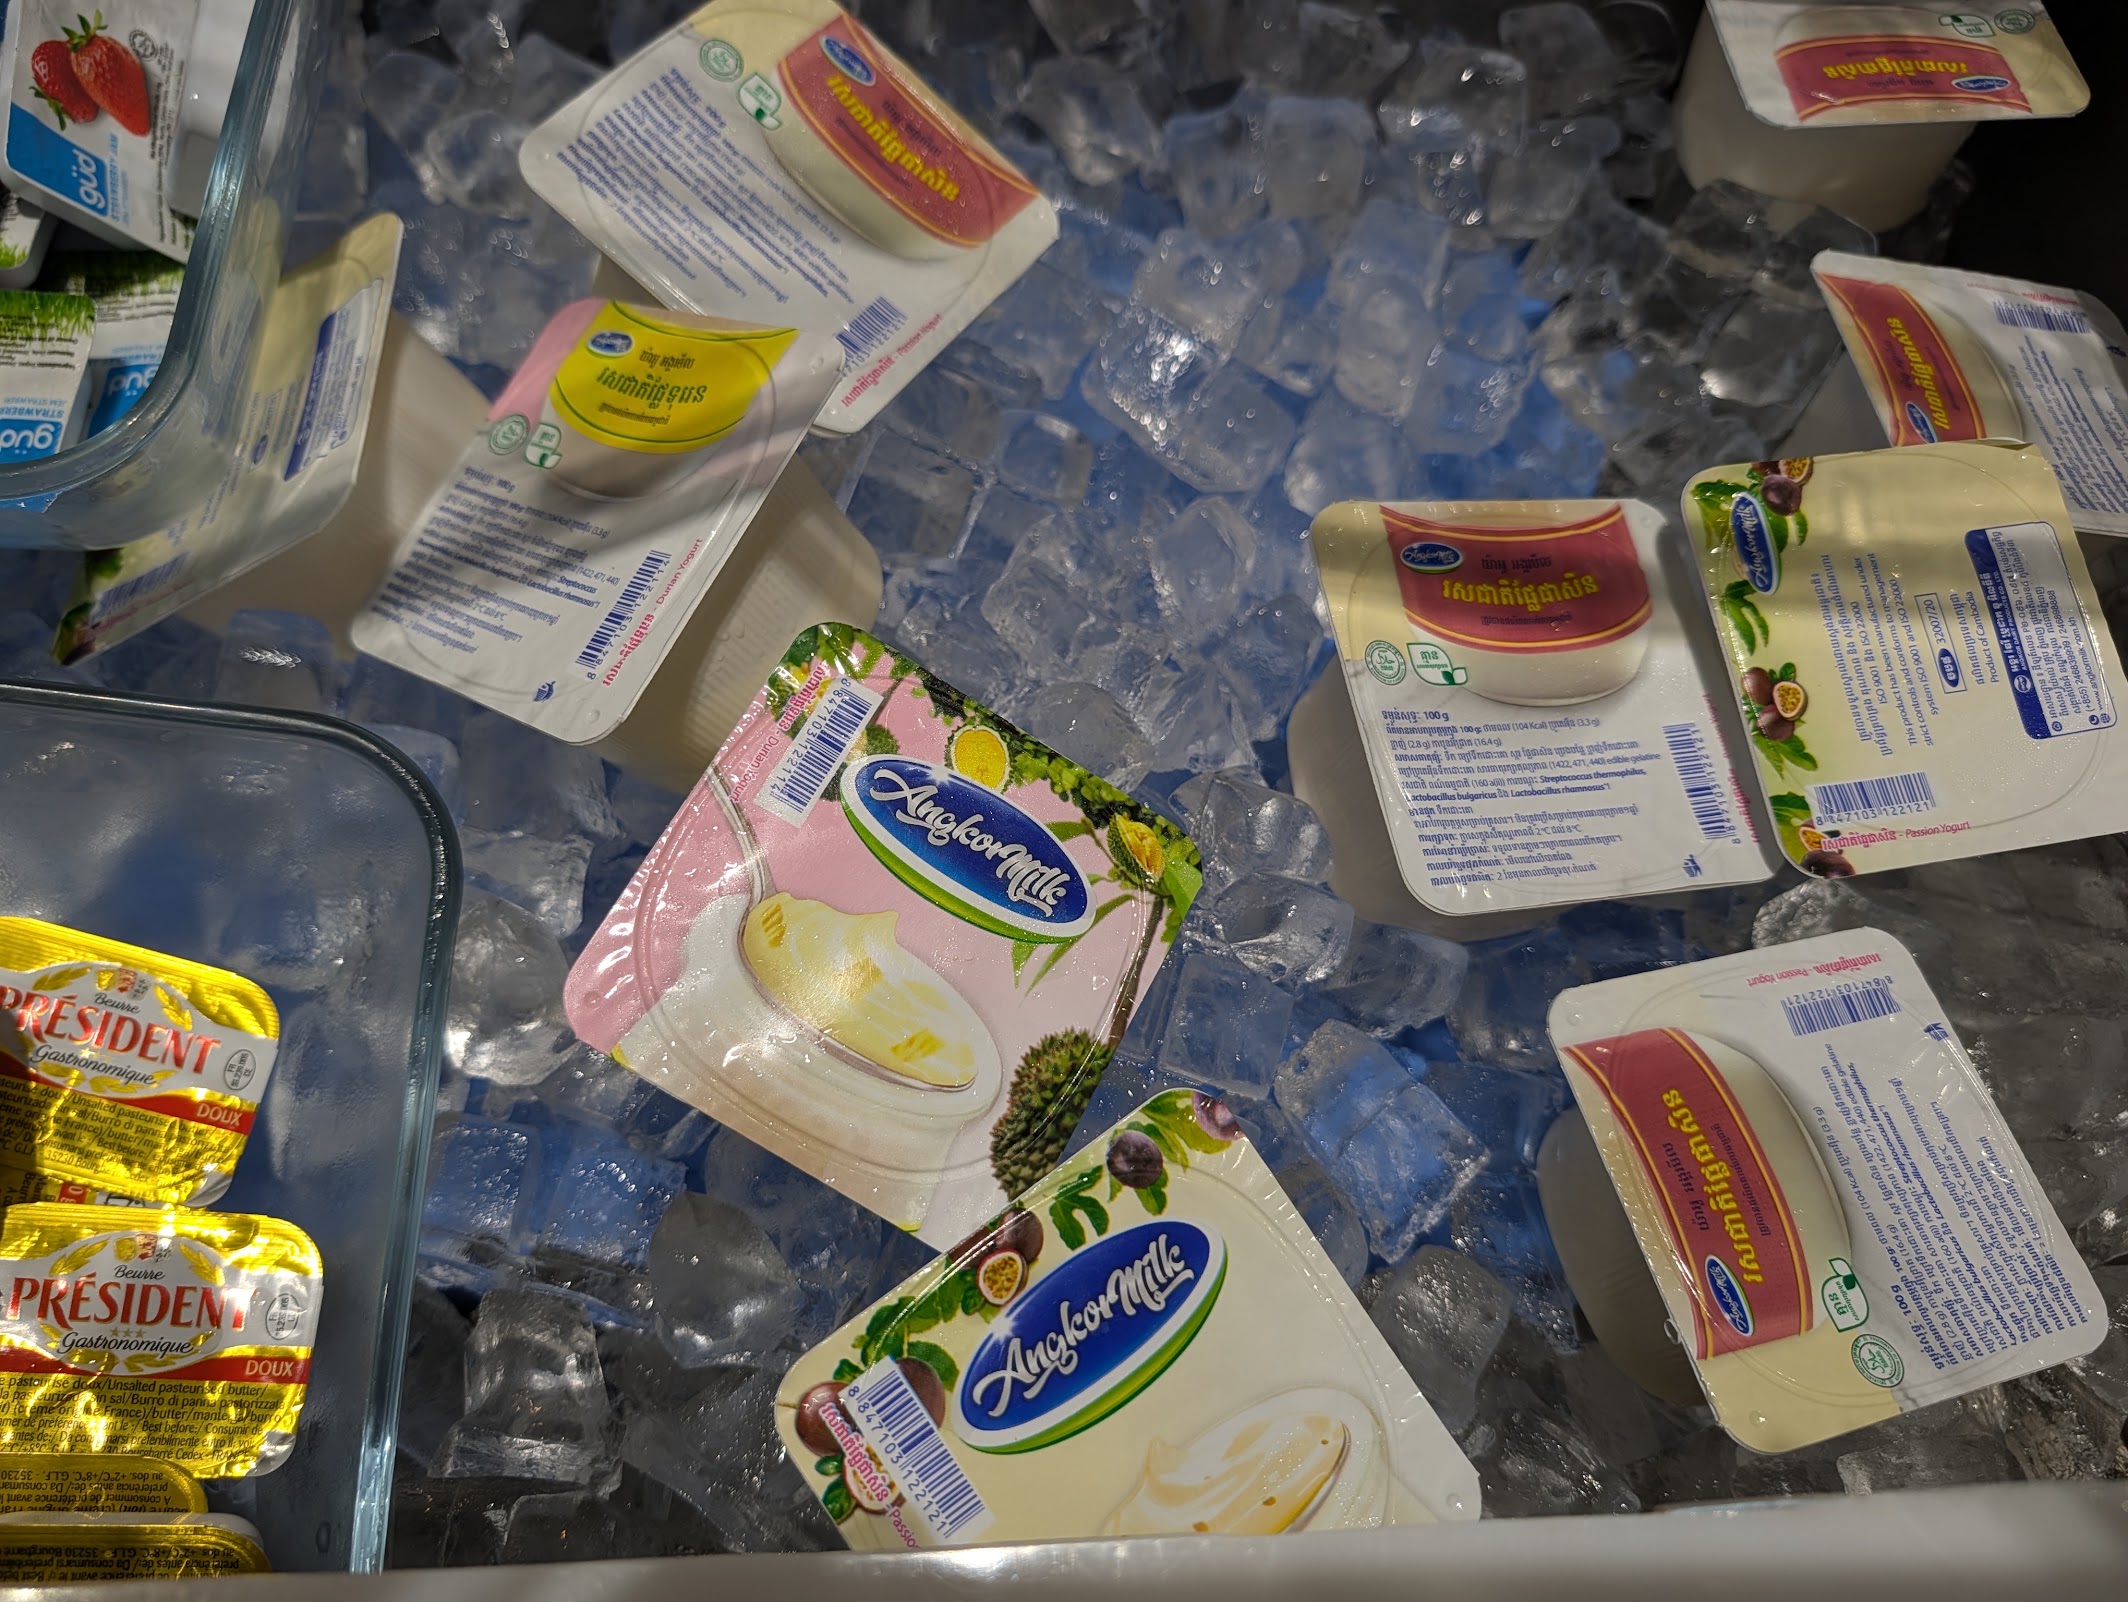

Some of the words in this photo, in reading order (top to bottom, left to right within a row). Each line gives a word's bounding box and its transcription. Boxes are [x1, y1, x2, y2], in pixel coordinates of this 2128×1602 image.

[71, 148, 106, 209] güd
[655, 569, 681, 606] Durian
[678, 536, 703, 571] Yogurt
[1888, 577, 1904, 607] 22000
[586, 670, 596, 680] 8
[634, 556, 670, 610] 122114
[1849, 600, 1865, 629] 22000
[1859, 583, 1886, 647] manufactured
[1884, 613, 1893, 623] to
[1897, 606, 1909, 623] ISO
[1923, 597, 1946, 645] 32007/20
[1963, 590, 1985, 637] Cambodia
[2000, 595, 2014, 626] PRODUCTS
[1858, 629, 1870, 646] ISO
[1901, 622, 1914, 642] and
[1977, 636, 1988, 647] of
[2009, 626, 2019, 645] DAIRY
[1886, 623, 1907, 667] conforms
[1908, 643, 1922, 666] 9001
[1878, 647, 1893, 672] been
[1982, 647, 1999, 683] Product
[2015, 644, 2027, 671] ANGKOR
[839, 677, 851, 687] 8
[1868, 664, 1882, 687] 9001
[1887, 672, 1898, 689] has
[1900, 666, 1913, 686] and
[1915, 665, 1927, 682] ISO
[1874, 686, 1887, 705] ISO
[1906, 685, 1926, 723] controls
[1921, 681, 1939, 716] system
[2078, 684, 2095, 713] (+855)
[805, 687, 843, 739] 847103
[1424, 712, 1441, 720] 100
[1442, 712, 1449, 721] g
[1891, 688, 1913, 727] product
[1904, 726, 1918, 746] This
[1918, 723, 1934, 747] strict
[750, 734, 779, 771] Durian
[1690, 728, 1715, 776] 122121
[769, 740, 808, 793] 122114
[728, 766, 758, 803] Yogurt
[1456, 791, 1497, 802] bulgaricus
[1510, 785, 1561, 797] Lactobacillus
[1711, 783, 1735, 831] 847103
[1816, 816, 1823, 826] 8
[1829, 805, 1877, 827] 847103
[1882, 798, 1930, 819] 122121
[1905, 822, 1939, 840] Passion
[1939, 818, 1970, 835] Yogurt
[870, 769, 1070, 917] AngkorMilk
[1745, 971, 1776, 988] Yogurt
[1775, 966, 1807, 981] Passion
[1884, 974, 1892, 984] 8
[1785, 987, 1831, 1006] 122121
[1834, 976, 1881, 995] 847103
[94, 992, 142, 1015] Beurre
[29, 1044, 158, 1087] Gastronomique
[1820, 1041, 1847, 1078] gelatine
[1838, 1076, 1860, 1105] edible
[1844, 1060, 1880, 1123] thermophilus,
[196, 1103, 243, 1126] DOUX
[1811, 1104, 1824, 1117] g)
[1851, 1103, 1869, 1125] 440)
[1815, 1115, 1831, 1134] (3.3
[1862, 1124, 1879, 1145] 471,
[97, 1137, 116, 1150] Best
[1875, 1121, 1912, 1185] Streptococcus
[1870, 1142, 1893, 1173] (1422,
[1841, 1166, 1860, 1190] Kcal)
[1905, 1159, 1945, 1220] Lactobacillus
[1852, 1188, 1870, 1210] (104
[1963, 1189, 1972, 1197] 2
[1886, 1222, 1898, 1234] g)
[1884, 1243, 1896, 1256] g:
[1891, 1232, 1910, 1258] (16.4
[1939, 1244, 1957, 1265] (160
[1889, 1254, 1903, 1273] 100
[1948, 1235, 1980, 1284] bulgaricus
[113, 1264, 166, 1280] Beurre
[1889, 1282, 1901, 1293] g
[5, 1272, 259, 1332] PRÉSIDENT
[1893, 1292, 1912, 1317] 100
[973, 1234, 1194, 1417] AngkorMilk
[1934, 1308, 1948, 1322] g)
[1977, 1284, 2017, 1346] Lactobacillus
[1941, 1319, 1957, 1339] (2.8
[56, 1332, 194, 1356] Gastronomique
[245, 1360, 294, 1377] DOUX
[168, 1395, 178, 1405] di
[24, 1418, 35, 1428] de
[142, 1421, 163, 1432] Best
[205, 1422, 248, 1434] Consumir
[60, 1431, 71, 1442] Da
[846, 1384, 860, 1397] 8
[855, 1400, 905, 1464] 847103
[899, 1468, 948, 1531] 122121
[1, 1471, 33, 1481] 35230
[50, 1481, 63, 1491] Da
[91, 1482, 113, 1491] antes
[153, 1472, 163, 1480] au
[104, 1495, 164, 1504] consommer
[166, 1495, 172, 1505] A
